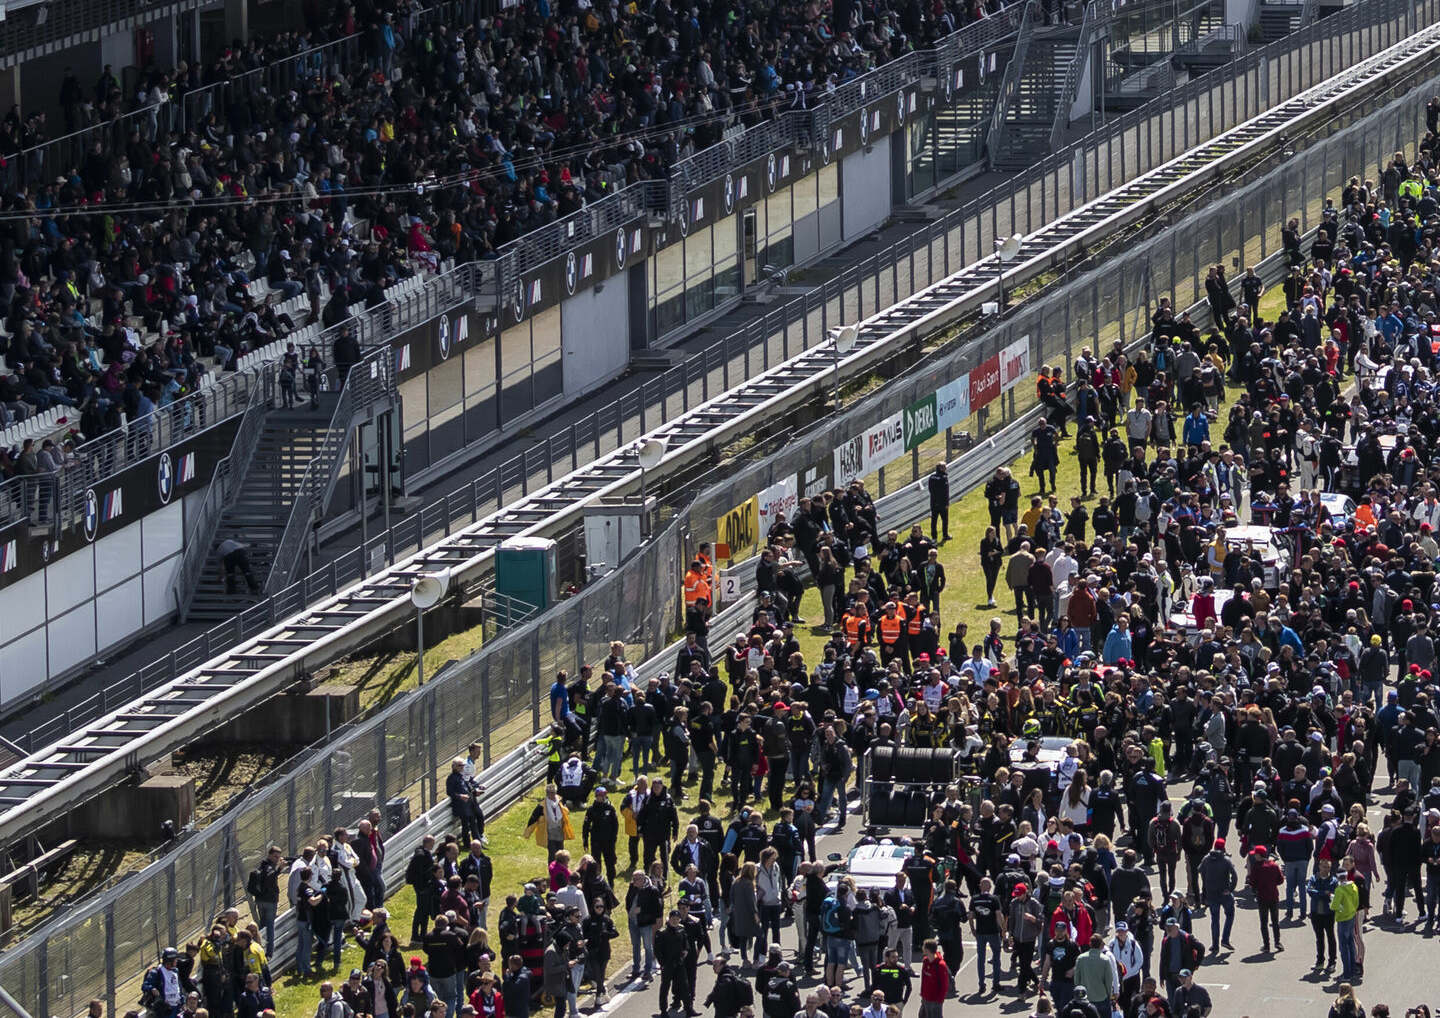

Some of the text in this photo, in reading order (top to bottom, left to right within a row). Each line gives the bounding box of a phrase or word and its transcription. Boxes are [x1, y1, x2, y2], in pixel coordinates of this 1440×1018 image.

[976, 369, 999, 395] Audi Sport
[914, 402, 934, 436] DEKRA
[871, 420, 902, 456] REMUS
[725, 502, 752, 554] ADAC
[727, 579, 735, 594] 2
